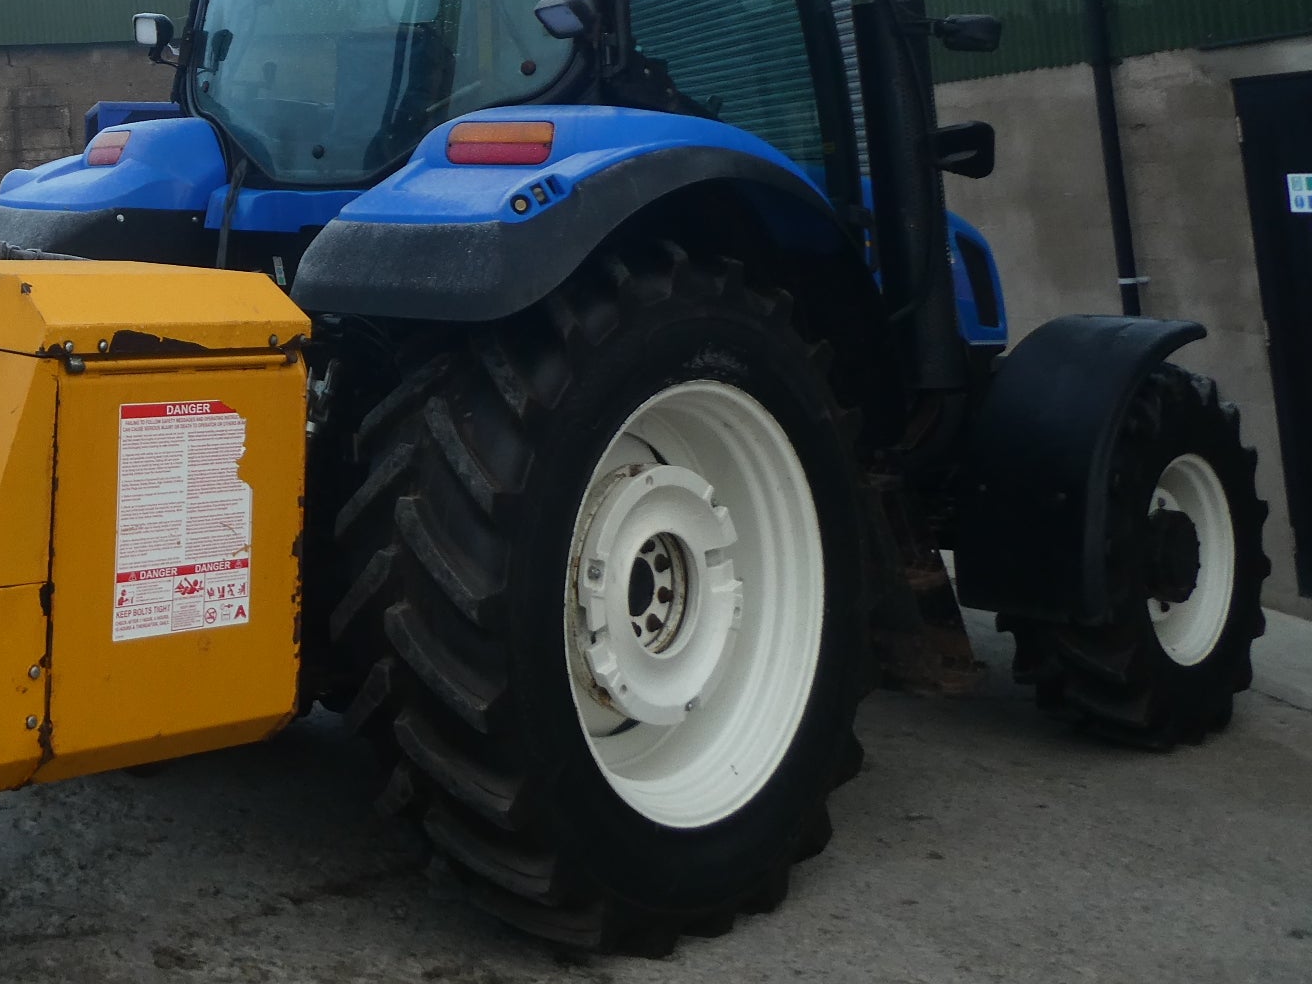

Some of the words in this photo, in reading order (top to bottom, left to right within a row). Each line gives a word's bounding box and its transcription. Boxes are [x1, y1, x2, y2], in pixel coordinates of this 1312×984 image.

[166, 403, 211, 415] DANGER
[194, 561, 231, 573] DANGER
[139, 567, 178, 580] DANGER
